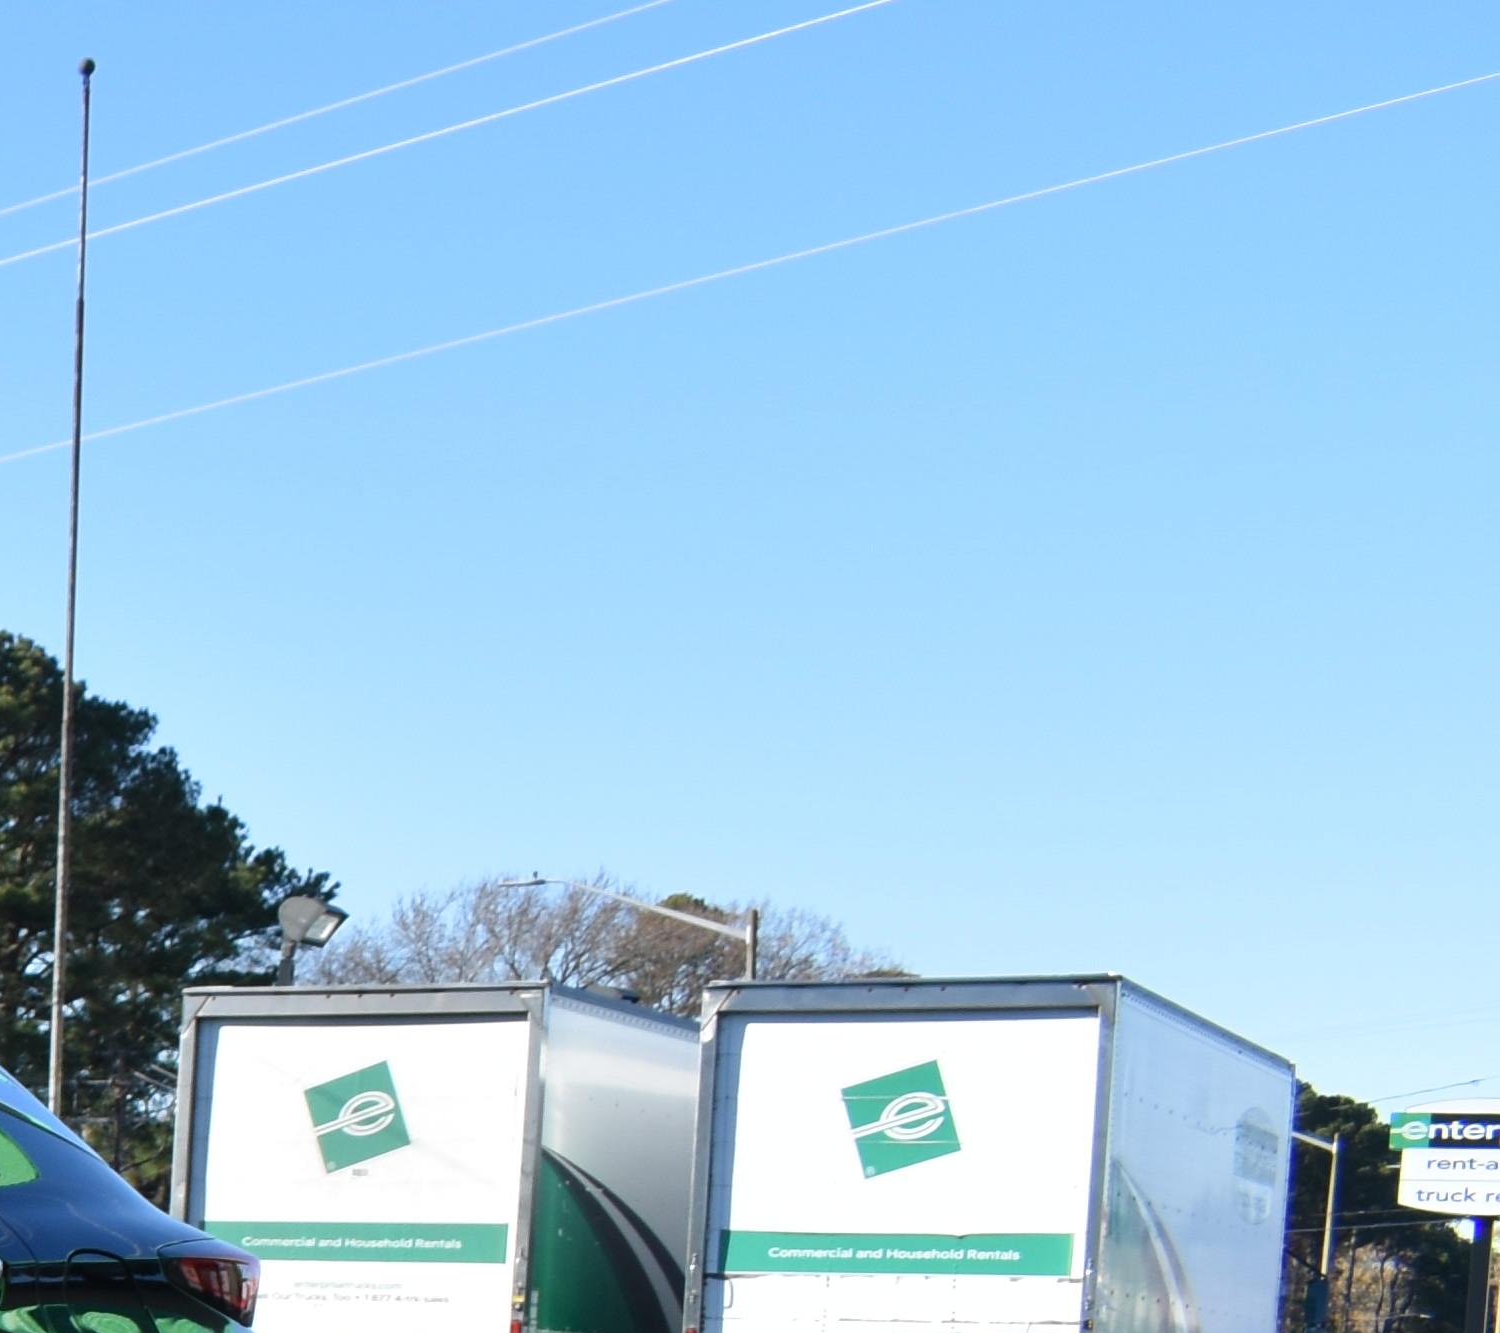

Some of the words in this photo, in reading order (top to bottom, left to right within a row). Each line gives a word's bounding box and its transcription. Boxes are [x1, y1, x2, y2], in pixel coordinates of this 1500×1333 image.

[1416, 1187, 1476, 1202] truck
[241, 1236, 316, 1248] Commercial
[318, 1237, 342, 1248] and
[345, 1237, 413, 1249] Household
[415, 1238, 462, 1249] Rentals
[767, 1246, 853, 1259] Commercial
[855, 1247, 883, 1259] and
[886, 1248, 964, 1260] Household
[966, 1249, 1020, 1261] Rentals
